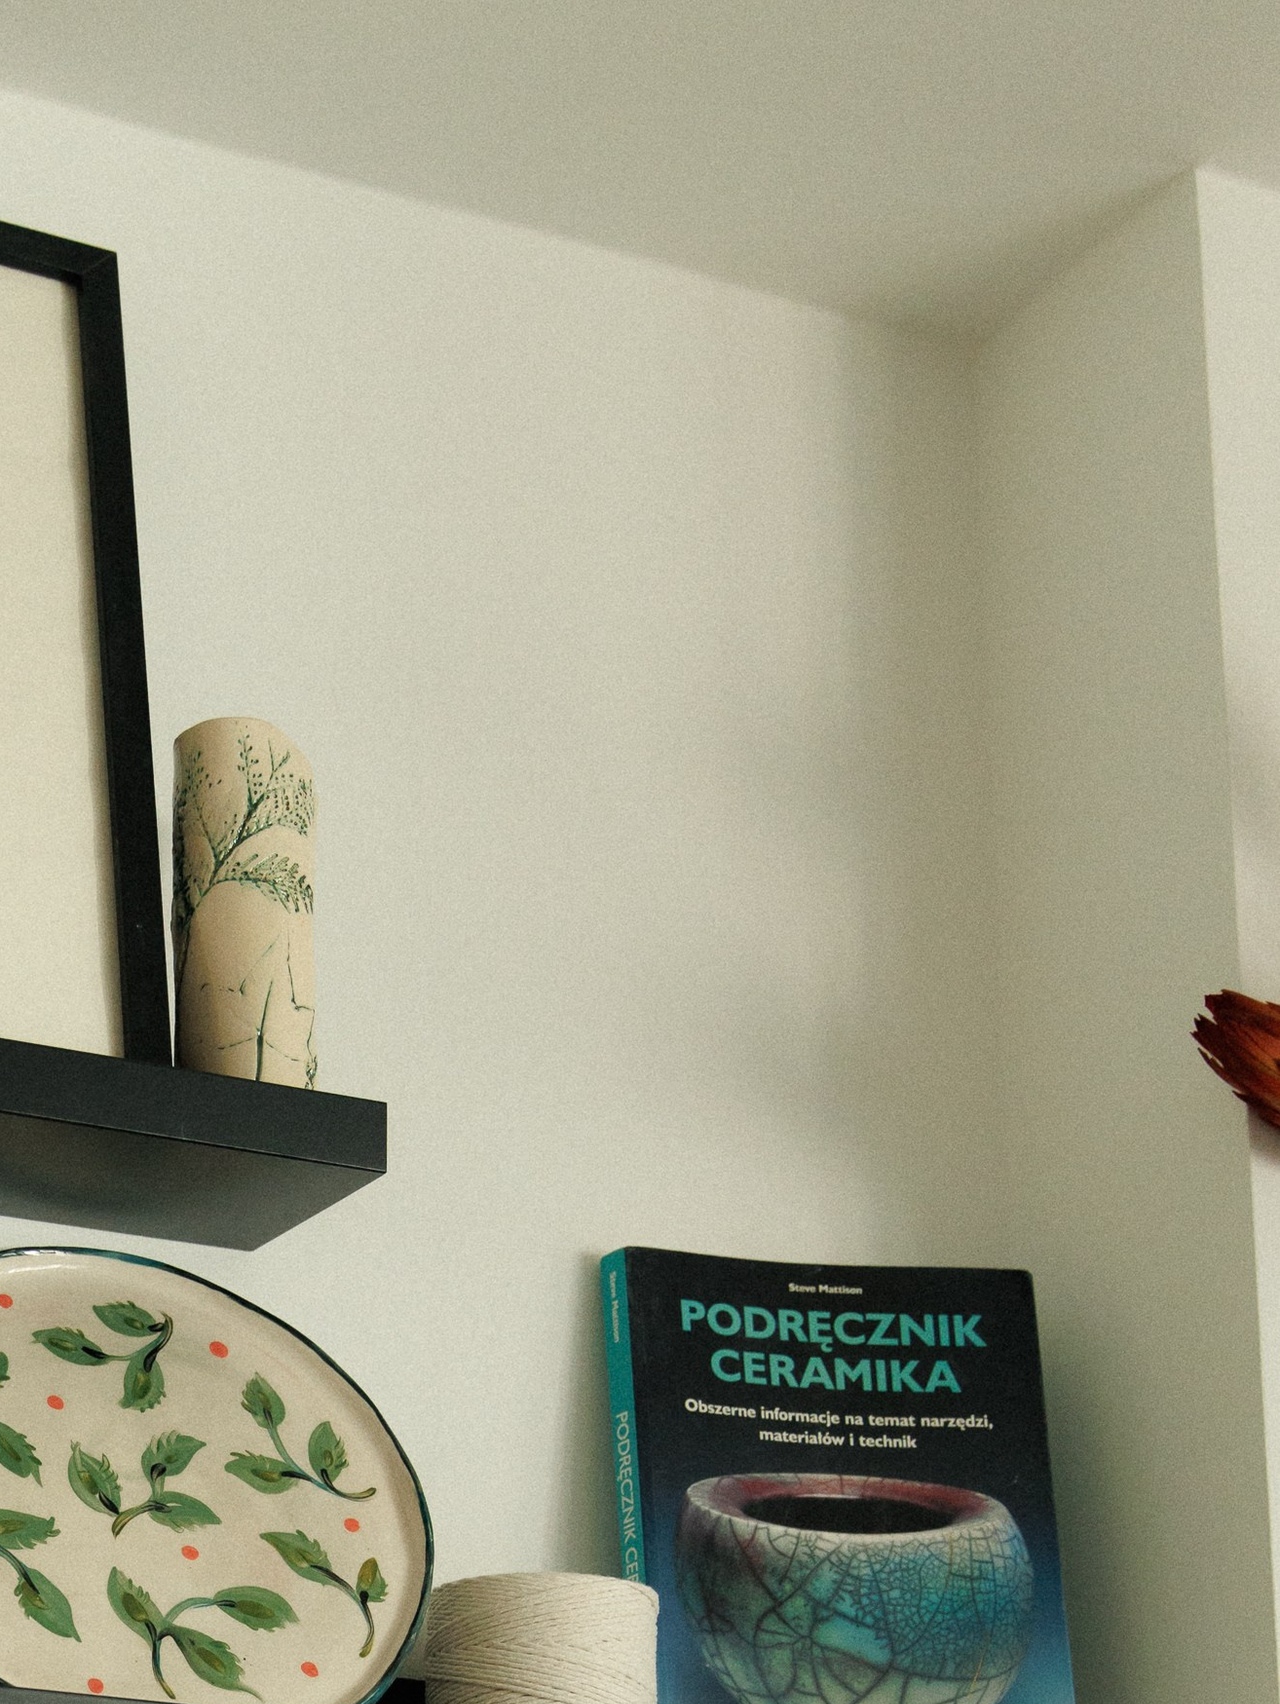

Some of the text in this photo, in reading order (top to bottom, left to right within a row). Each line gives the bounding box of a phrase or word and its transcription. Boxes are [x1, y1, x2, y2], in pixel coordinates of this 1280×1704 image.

[788, 1282, 863, 1295] Steve Mattison
[680, 1299, 988, 1353] PODRĘCZNIK
[710, 1349, 962, 1393] CERAMIKA
[684, 1398, 994, 1431] Obszerne informacje na temat narzędzi,
[759, 1428, 917, 1449] materiałów i technik
[615, 1411, 636, 1544] PODRĘCZNIK
